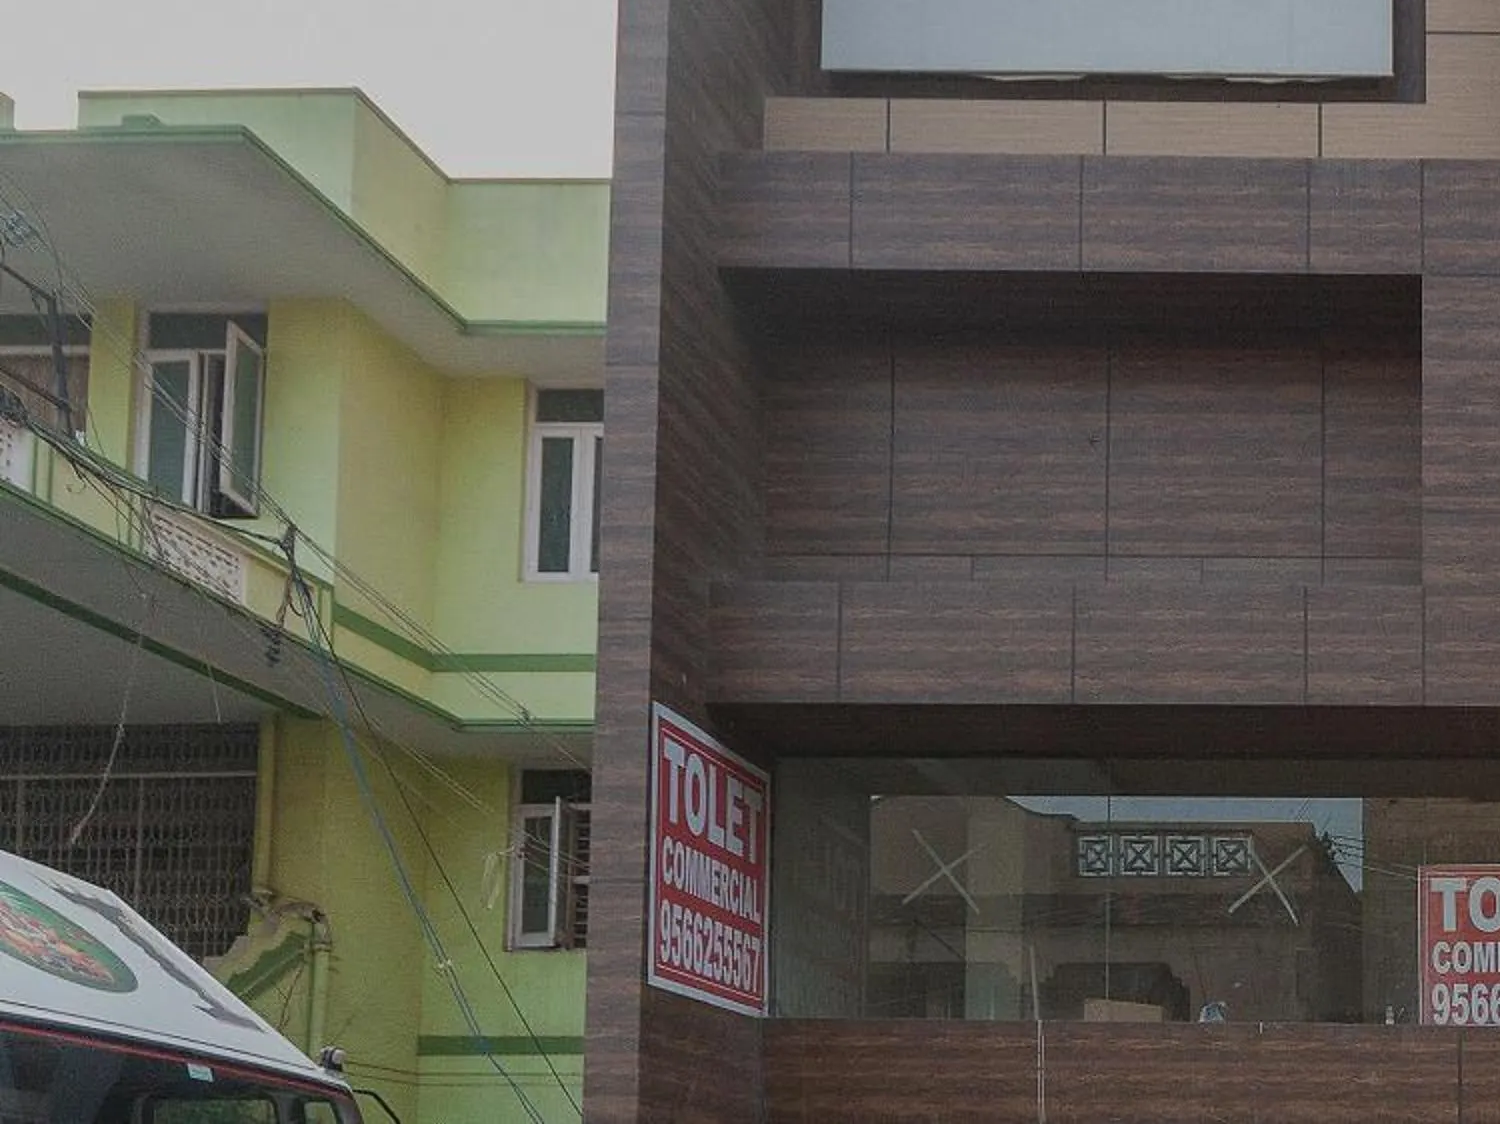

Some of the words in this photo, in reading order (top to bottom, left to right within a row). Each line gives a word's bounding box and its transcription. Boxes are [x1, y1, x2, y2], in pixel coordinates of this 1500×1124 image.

[663, 737, 763, 863] TOLET
[663, 836, 761, 924] COMMERCIAL
[660, 900, 761, 993] 9566255567
